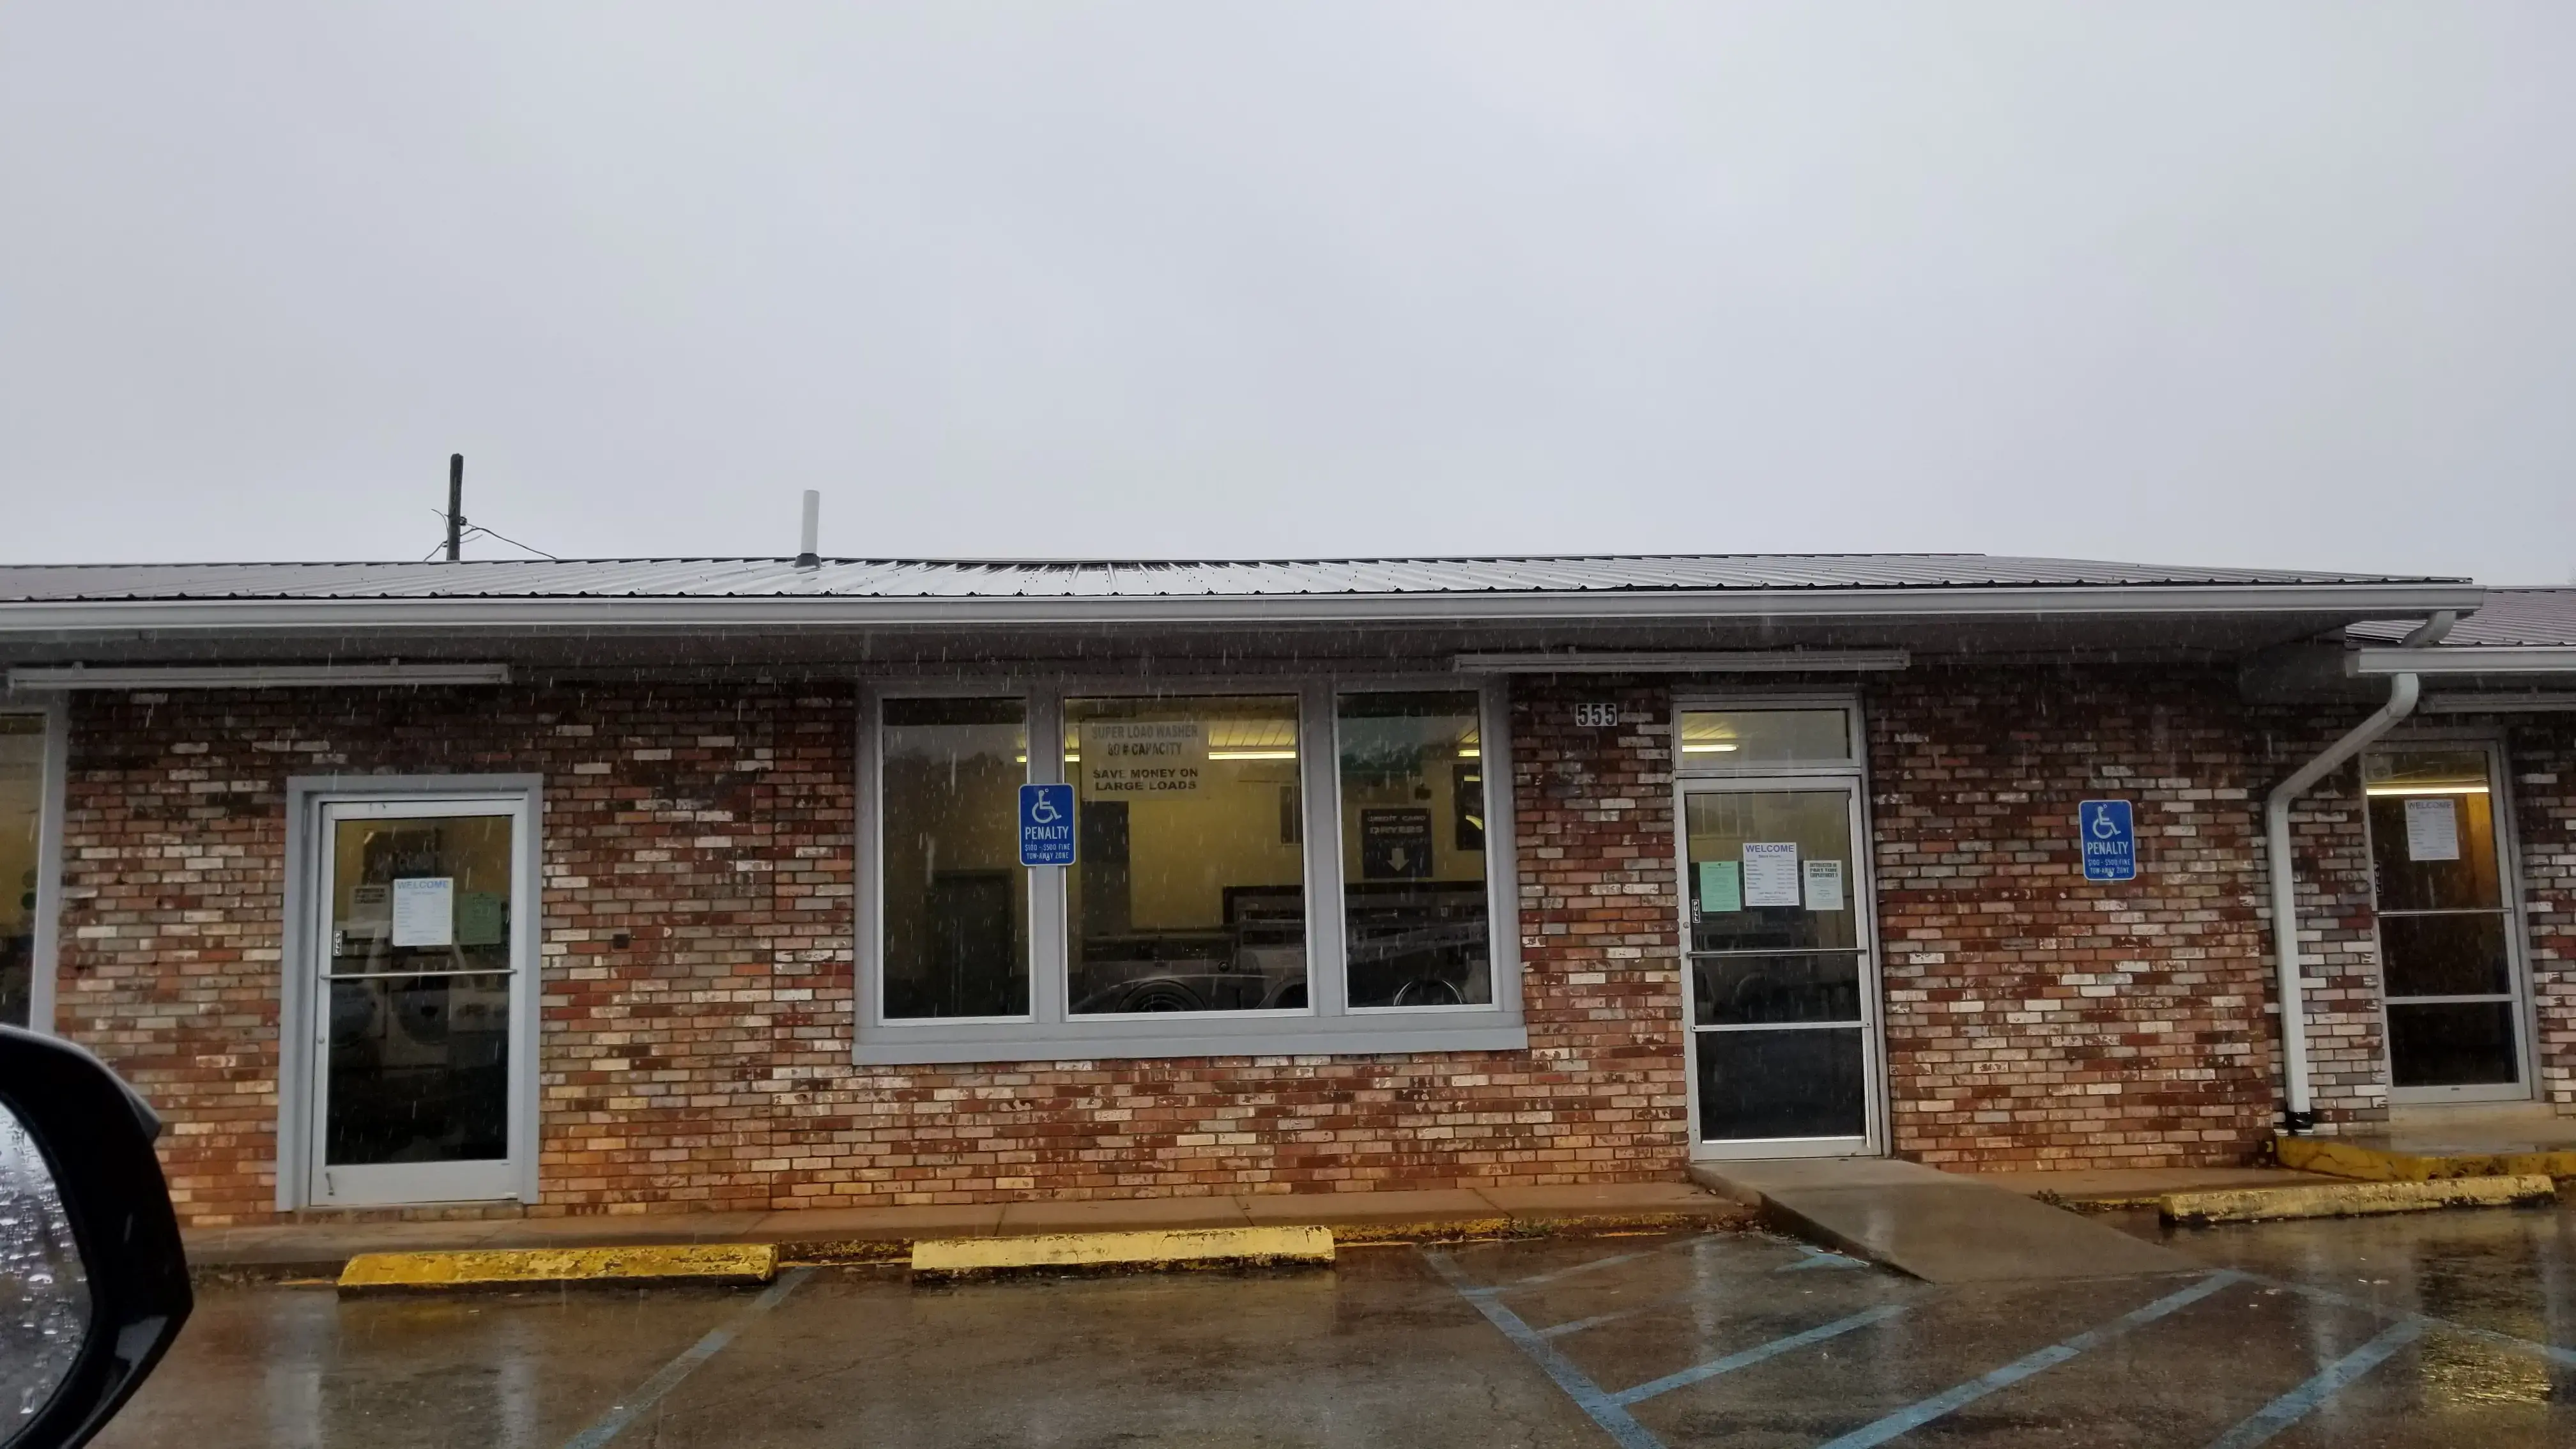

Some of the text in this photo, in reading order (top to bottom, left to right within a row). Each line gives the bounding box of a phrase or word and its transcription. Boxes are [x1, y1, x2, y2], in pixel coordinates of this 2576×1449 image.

[1577, 704, 1616, 725] 555
[1091, 724, 1198, 739] SUPER LOAD WASHER
[1131, 742, 1182, 755] CAPACITY
[1093, 768, 1198, 779] SAVE MONEY ON
[1095, 781, 1197, 791] LARGE LOADS
[1025, 826, 1069, 839] PENALTY
[2087, 841, 2128, 855] PENALTY
[397, 880, 449, 889] WELCOME
